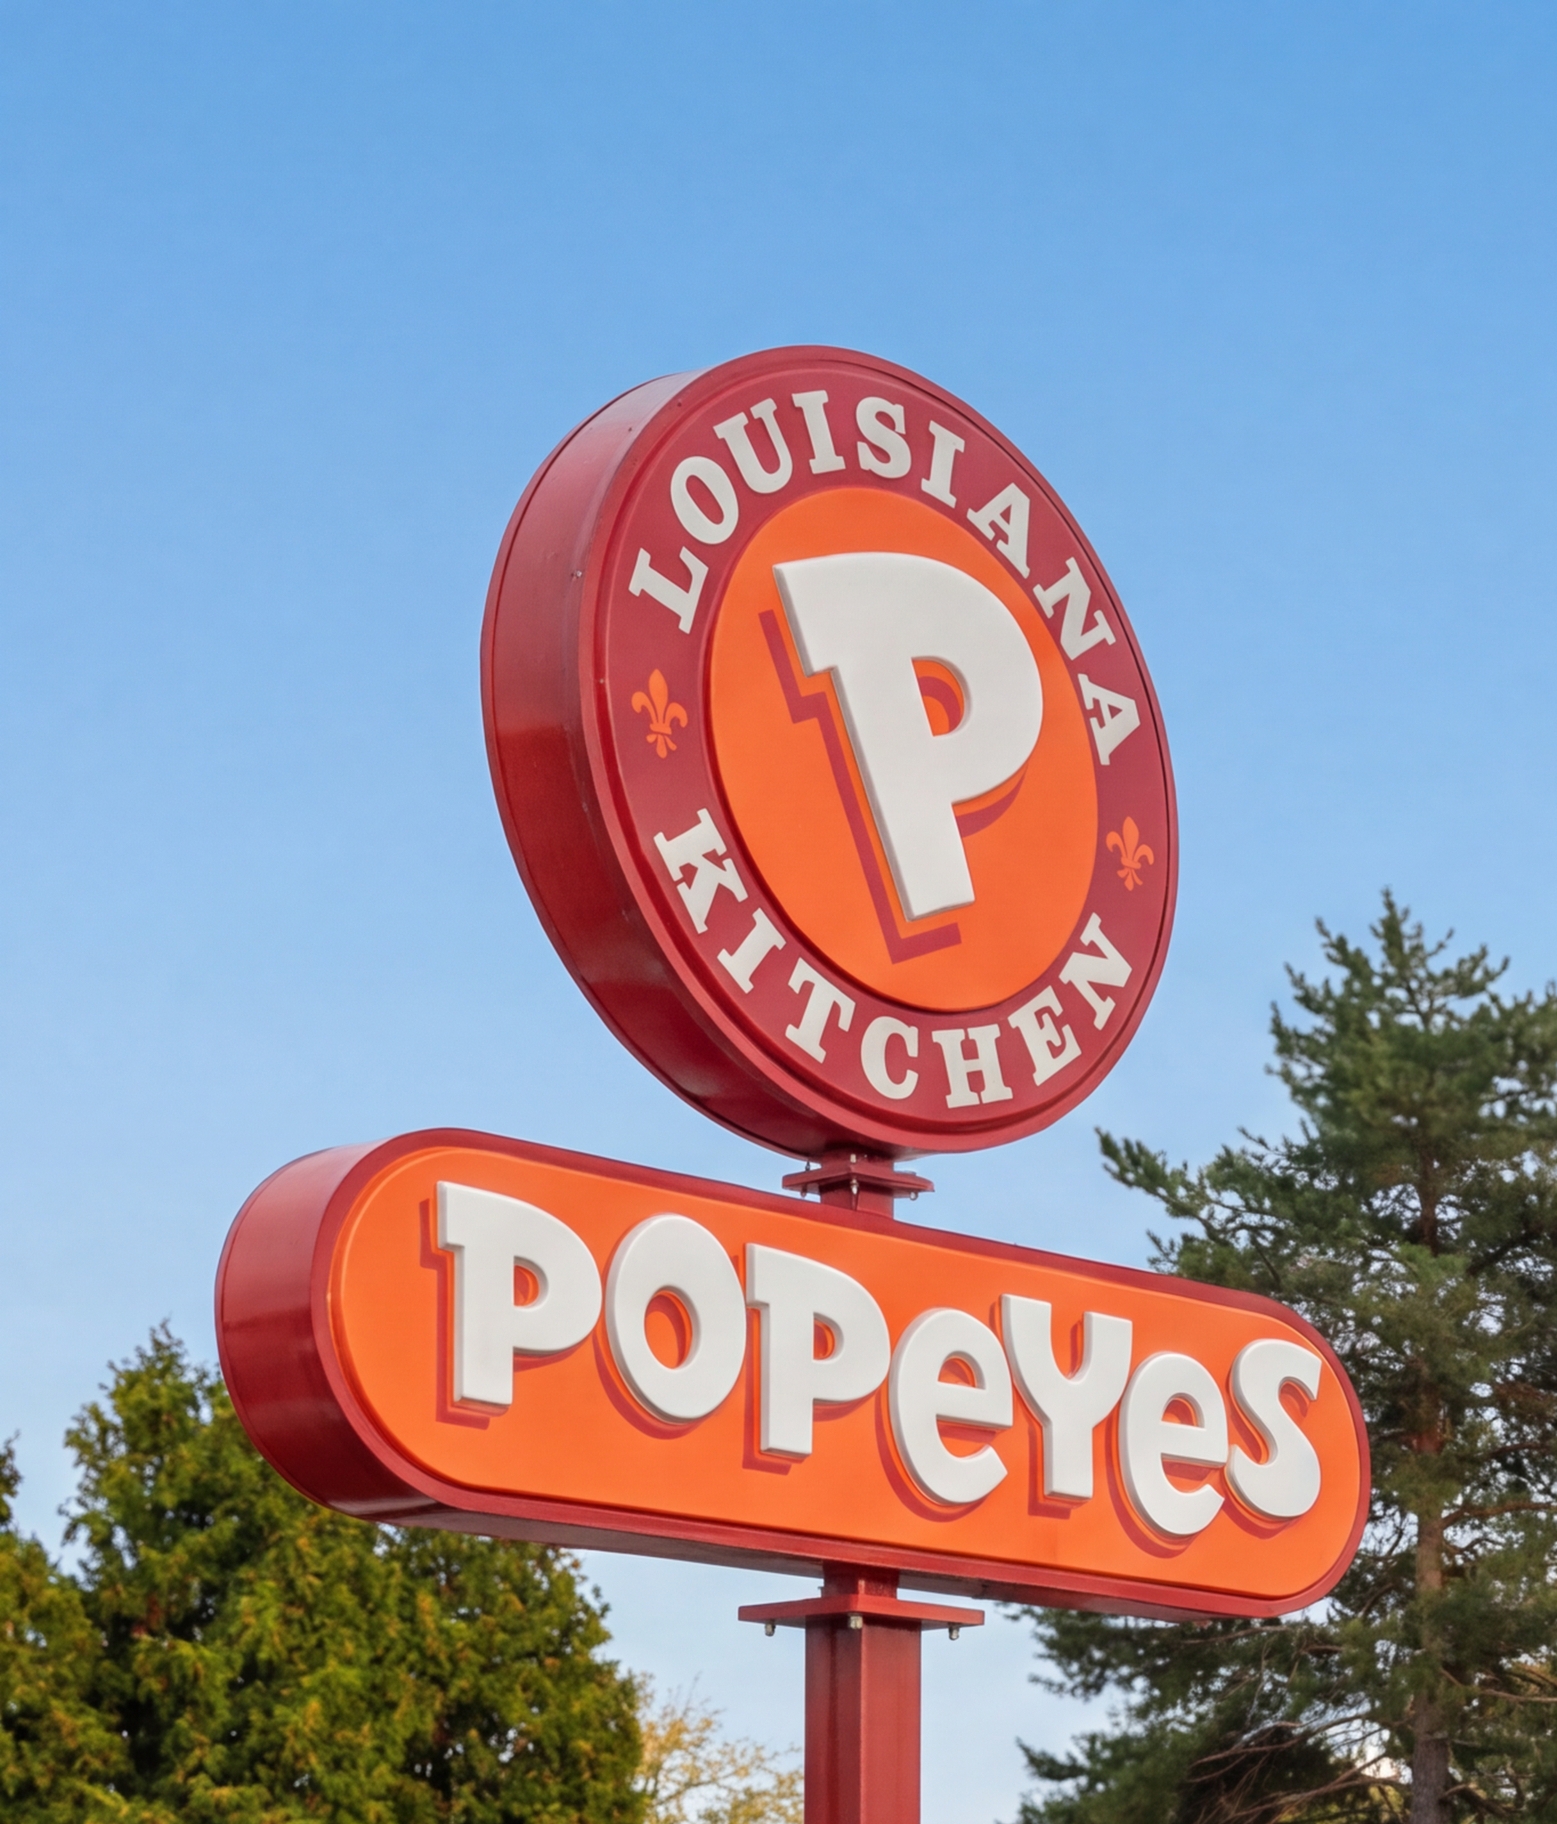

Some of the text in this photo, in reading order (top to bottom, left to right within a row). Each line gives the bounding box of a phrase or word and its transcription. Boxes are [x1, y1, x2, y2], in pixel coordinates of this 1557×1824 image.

[628, 389, 1142, 766] LOUISIANA
[772, 551, 1045, 923] P
[652, 808, 1134, 1109] KITCHEN
